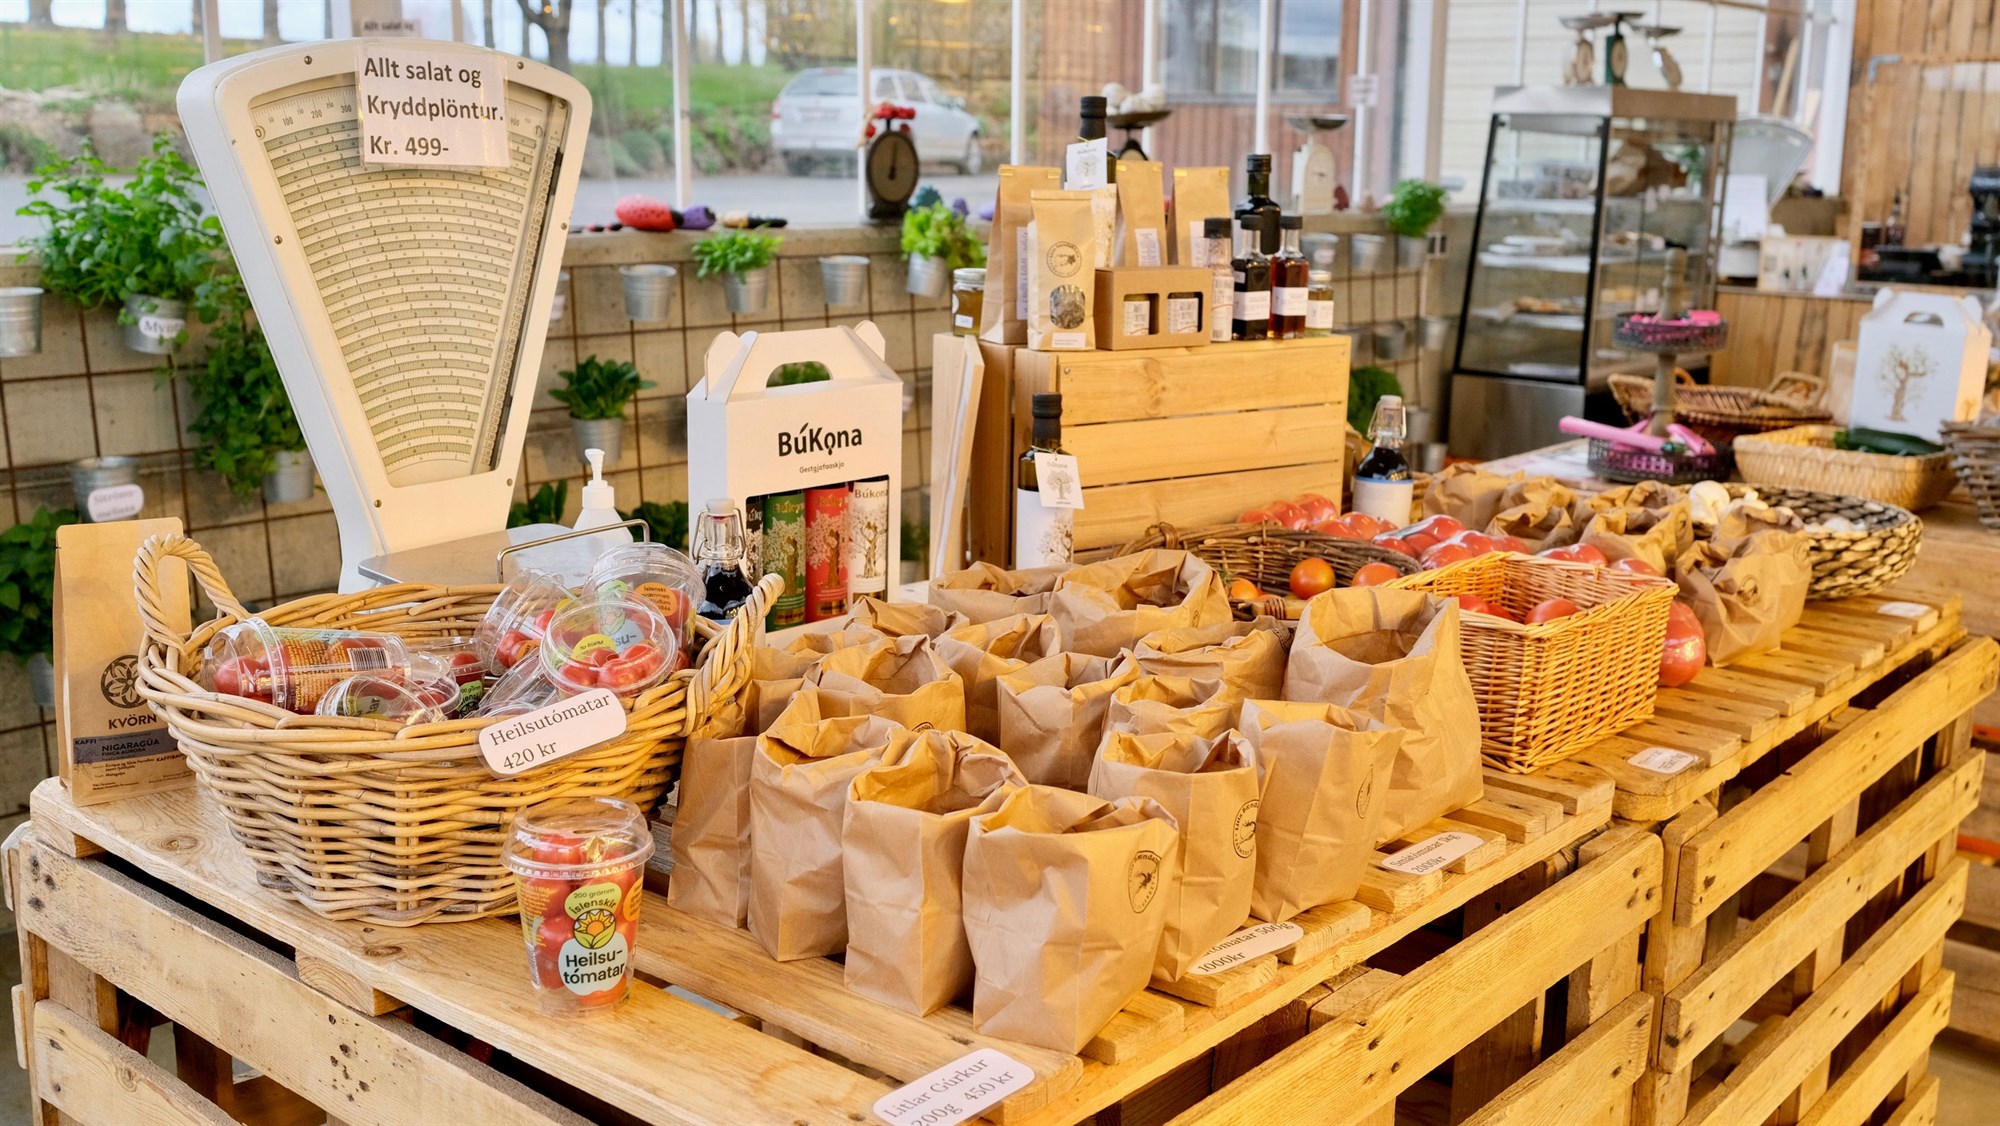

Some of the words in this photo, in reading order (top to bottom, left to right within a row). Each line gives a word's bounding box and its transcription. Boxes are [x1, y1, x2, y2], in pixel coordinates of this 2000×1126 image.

[364, 57, 399, 78] Allt
[406, 61, 453, 82] salat
[458, 69, 481, 88] og
[367, 94, 504, 121] Kryddplöntur.
[370, 135, 397, 155] Kr.
[405, 136, 449, 156] 499-
[778, 422, 863, 457] BúKona
[108, 713, 157, 730] KVÖRN
[489, 694, 610, 746] Heilsutómatar
[75, 738, 97, 746] KAFFI
[503, 748, 535, 770] 420
[537, 741, 557, 757] kr
[568, 899, 617, 915] Íslenskir
[1254, 922, 1294, 935] 500g
[565, 949, 623, 968] Heilsu-
[1197, 952, 1246, 973] 1000kr
[563, 963, 625, 985] tómatar
[883, 1092, 932, 1118] Litlar
[929, 1057, 989, 1094] Gúrkur
[963, 1082, 996, 1101] 450
[992, 1070, 1015, 1087] kr
